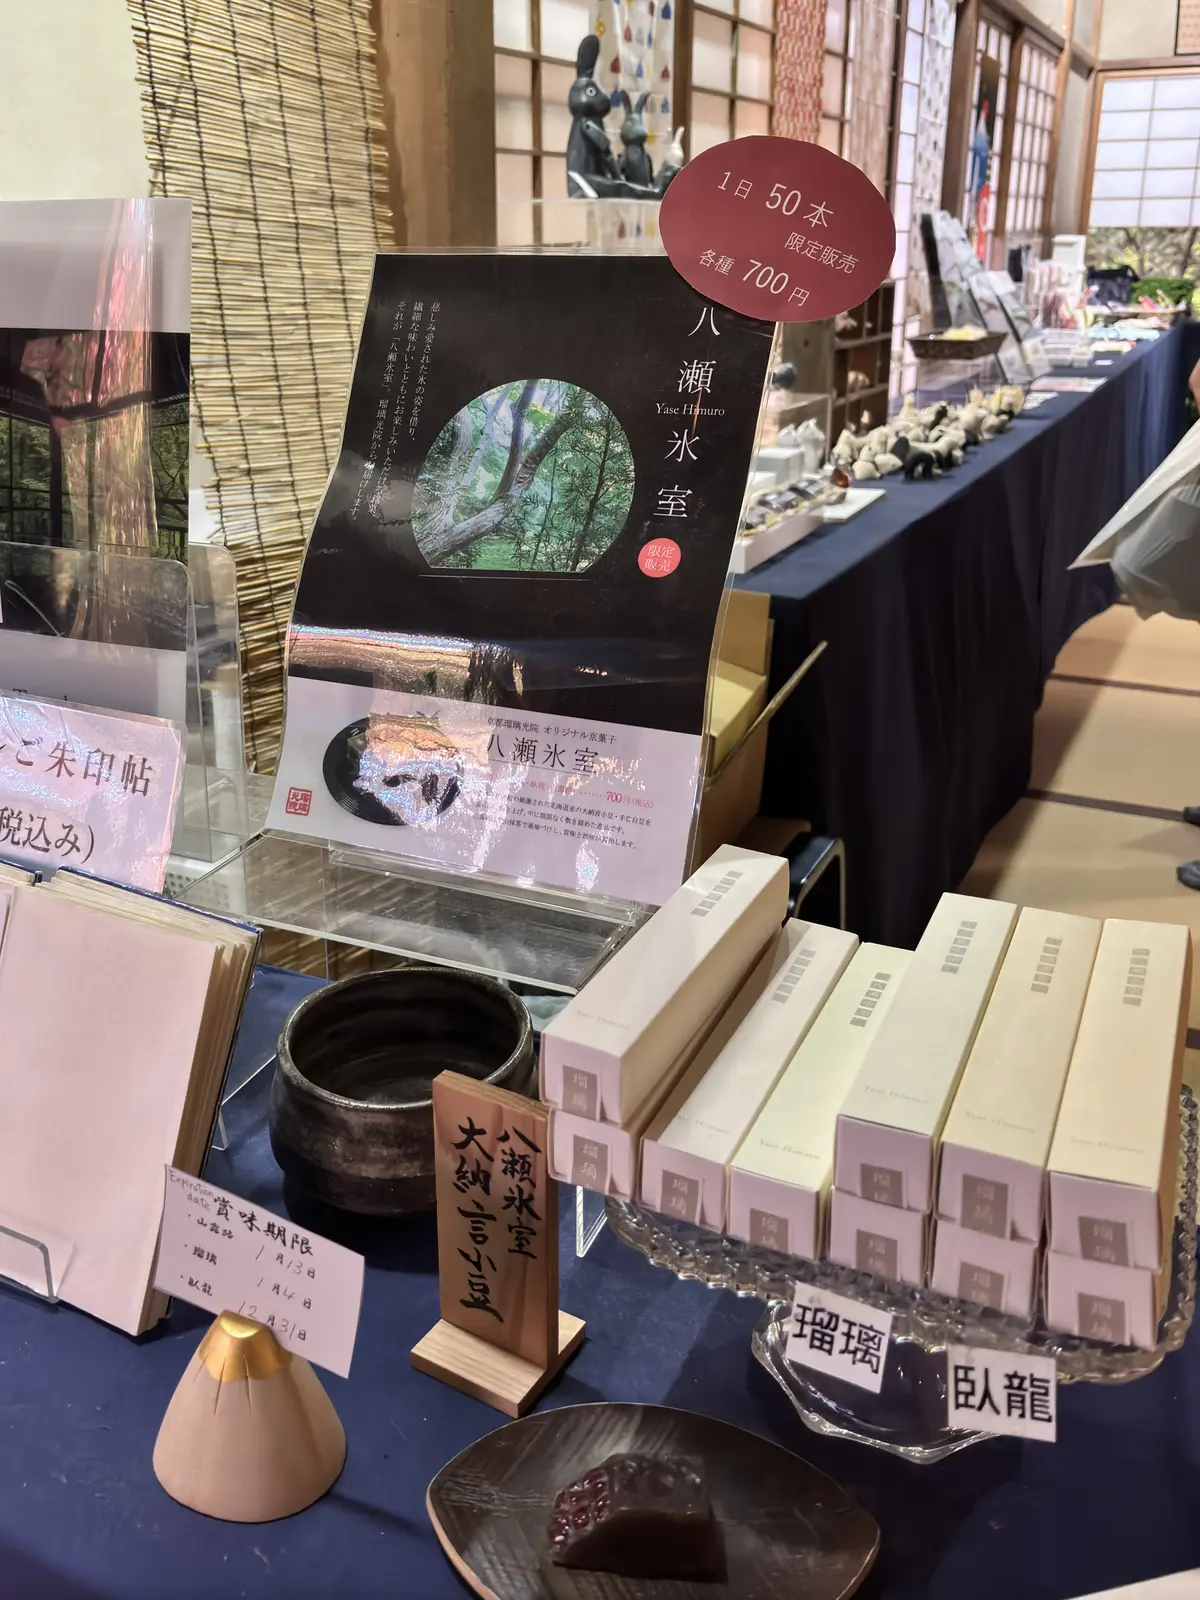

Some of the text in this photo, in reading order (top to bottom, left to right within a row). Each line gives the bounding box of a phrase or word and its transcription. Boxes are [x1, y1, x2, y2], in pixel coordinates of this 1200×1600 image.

[717, 171, 753, 200] 1日
[699, 248, 810, 307] 各種 700円
[784, 232, 859, 274] 限定販売
[656, 402, 725, 416] Yase Himuro
[647, 545, 675, 559] 限定
[487, 716, 617, 744] 京都瑠璃光院 オリジナル京菓子
[487, 734, 599, 775] 八瀬氷室
[0, 736, 154, 797] ご朱印帖
[450, 1116, 504, 1324] 大納言小豆
[496, 1125, 542, 1260] 八瀬氷室
[213, 1196, 314, 1257] 賞味期限
[791, 1303, 886, 1375] 瑠璃
[953, 1364, 1053, 1423] 臥龍
